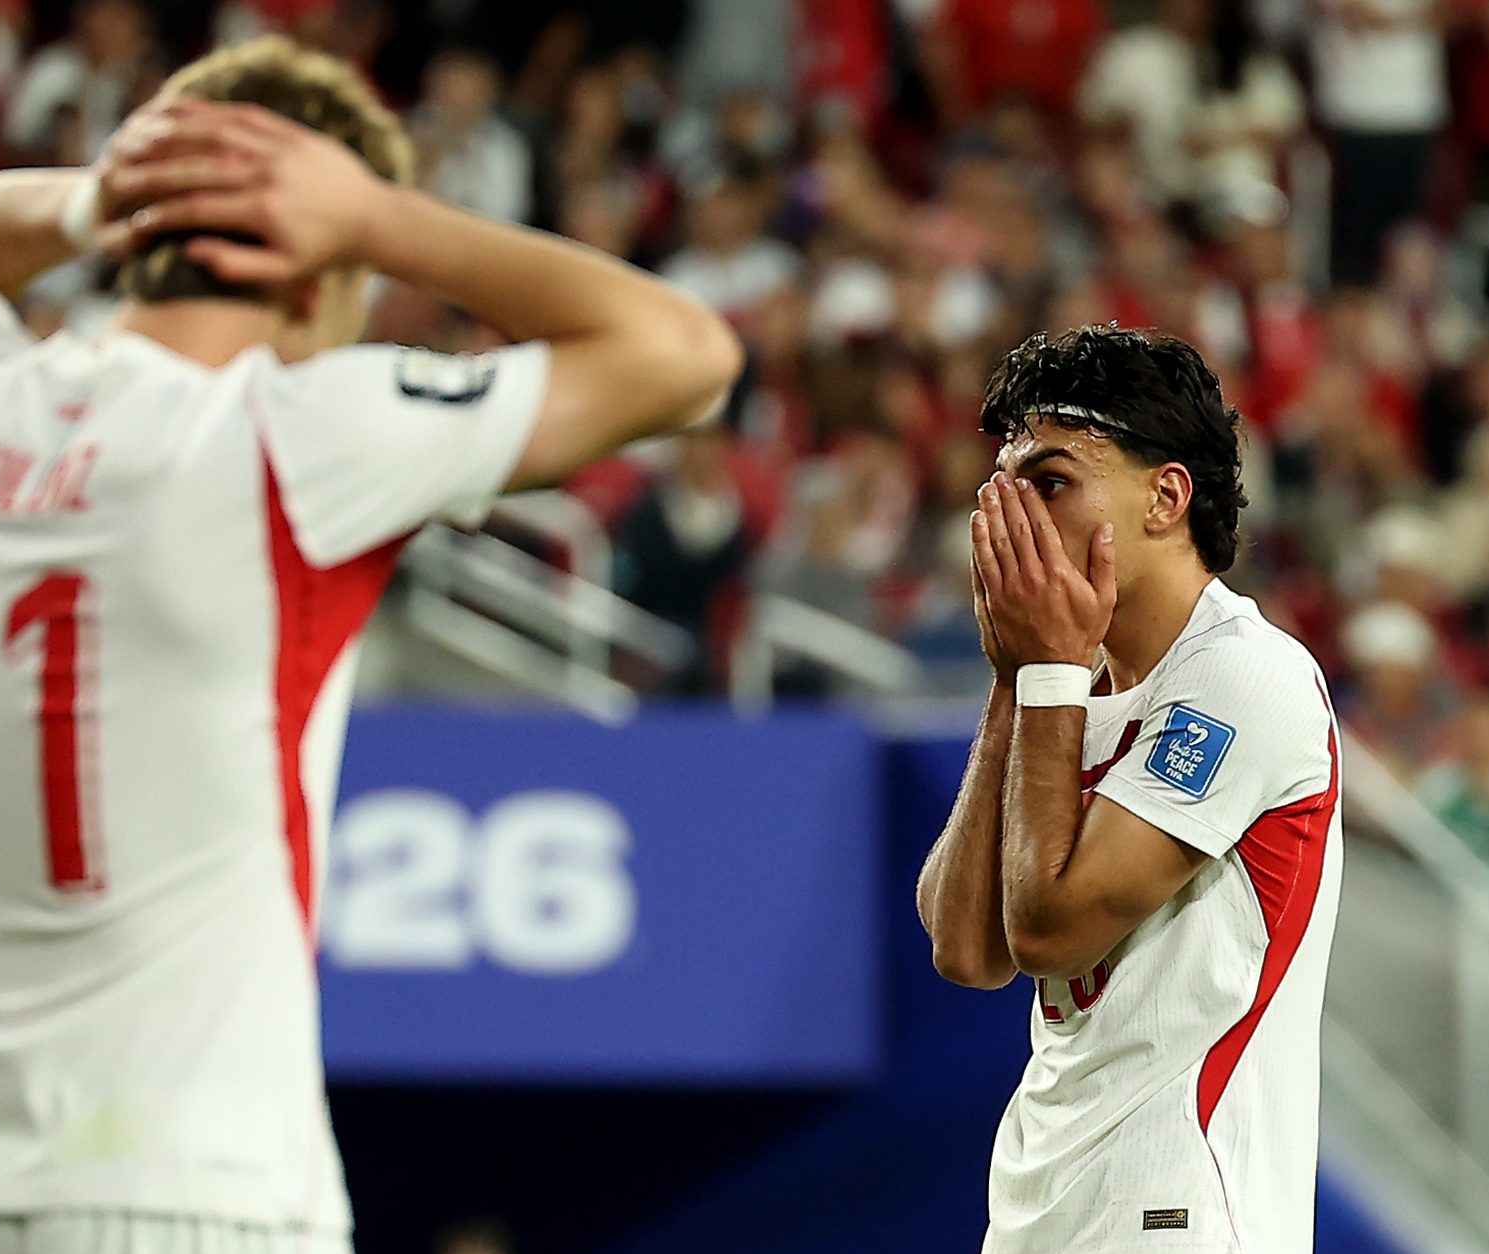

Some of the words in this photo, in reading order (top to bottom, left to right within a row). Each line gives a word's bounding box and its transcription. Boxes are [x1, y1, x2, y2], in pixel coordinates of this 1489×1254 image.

[1164, 751, 1198, 777] PEACE
[1165, 767, 1184, 782] FIFA
[328, 786, 640, 978] 26
